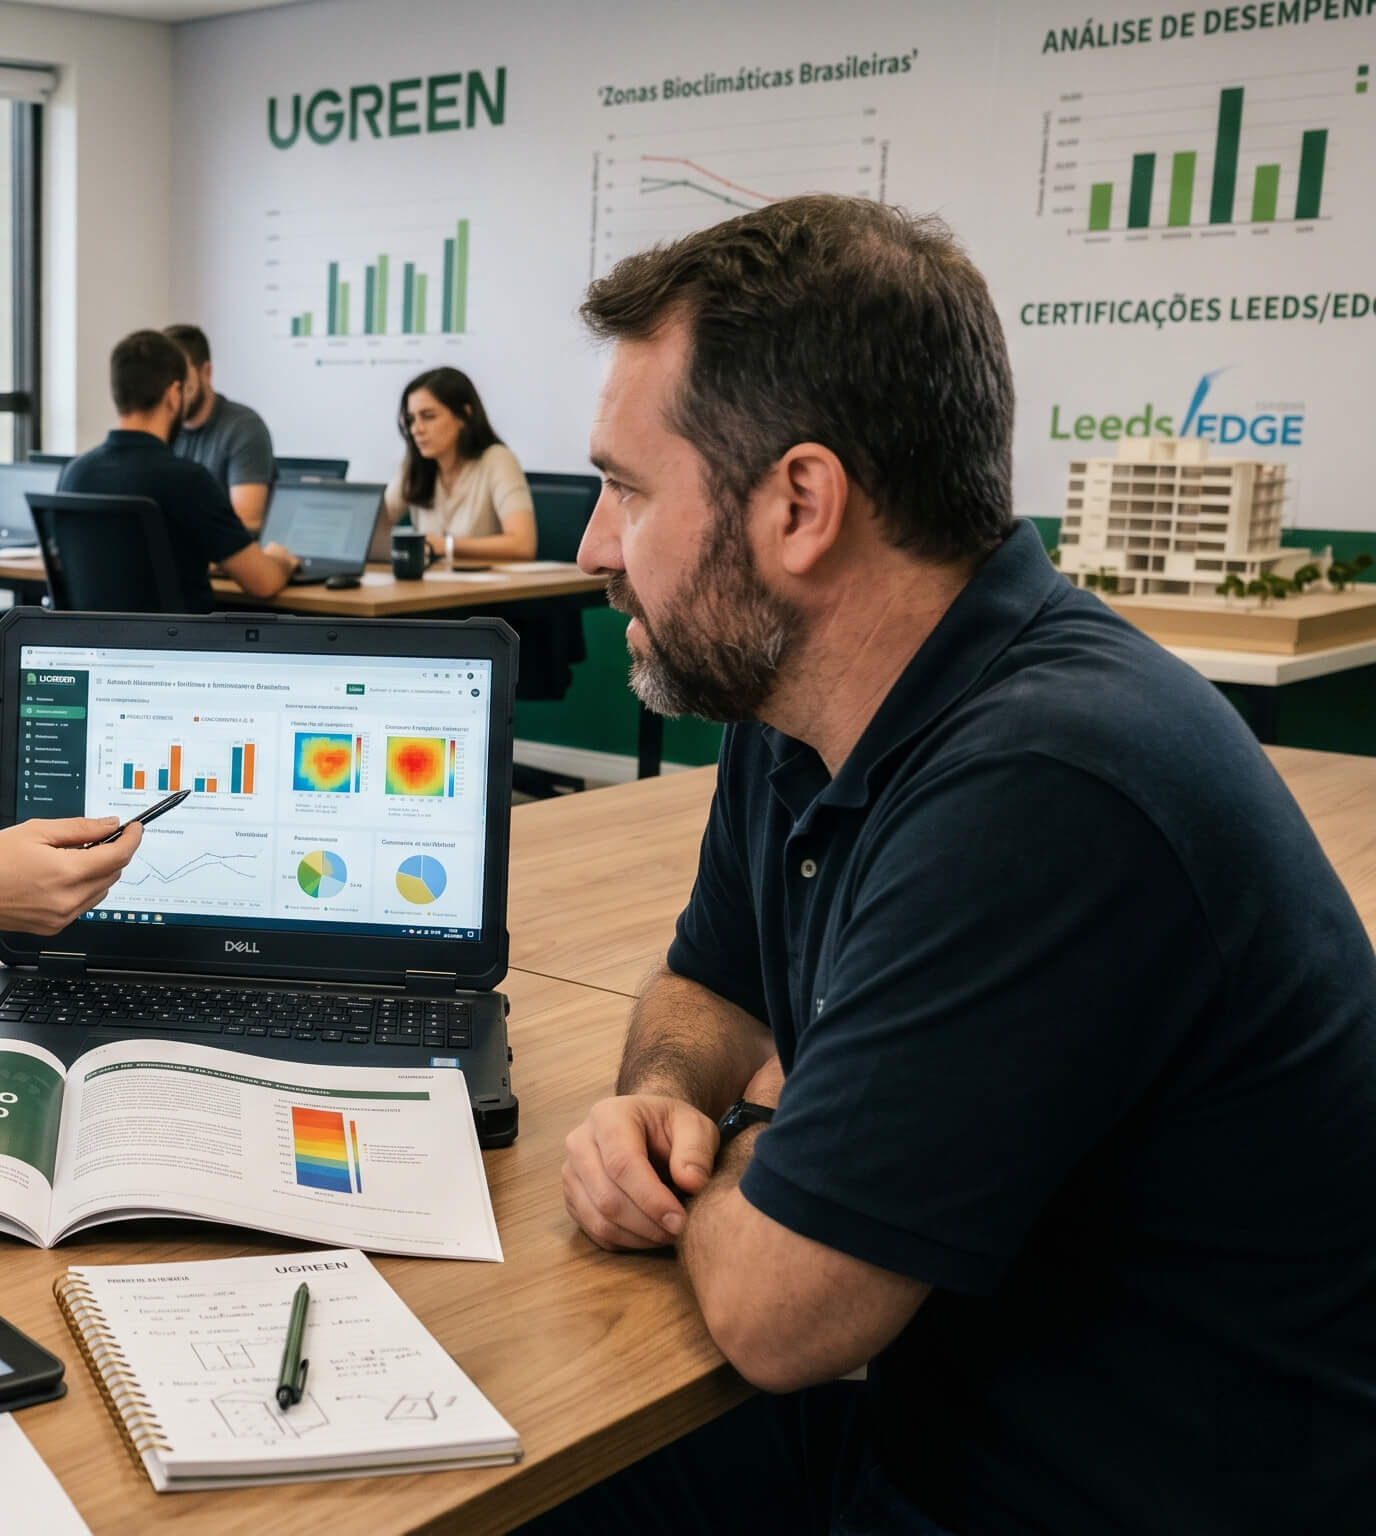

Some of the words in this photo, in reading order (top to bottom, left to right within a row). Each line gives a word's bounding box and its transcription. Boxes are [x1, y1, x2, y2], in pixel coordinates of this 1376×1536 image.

[1042, 18, 1153, 54] ANÁLISE
[1161, 12, 1196, 40] DE
[663, 66, 794, 100] Bioclimáticas
[268, 66, 507, 150] UGREEN
[1020, 293, 1222, 330] CERTIFICAÇÕES
[1230, 290, 1376, 325] LEEDS/ED
[224, 940, 261, 953] DELL
[274, 1261, 349, 1274] UGREEN
